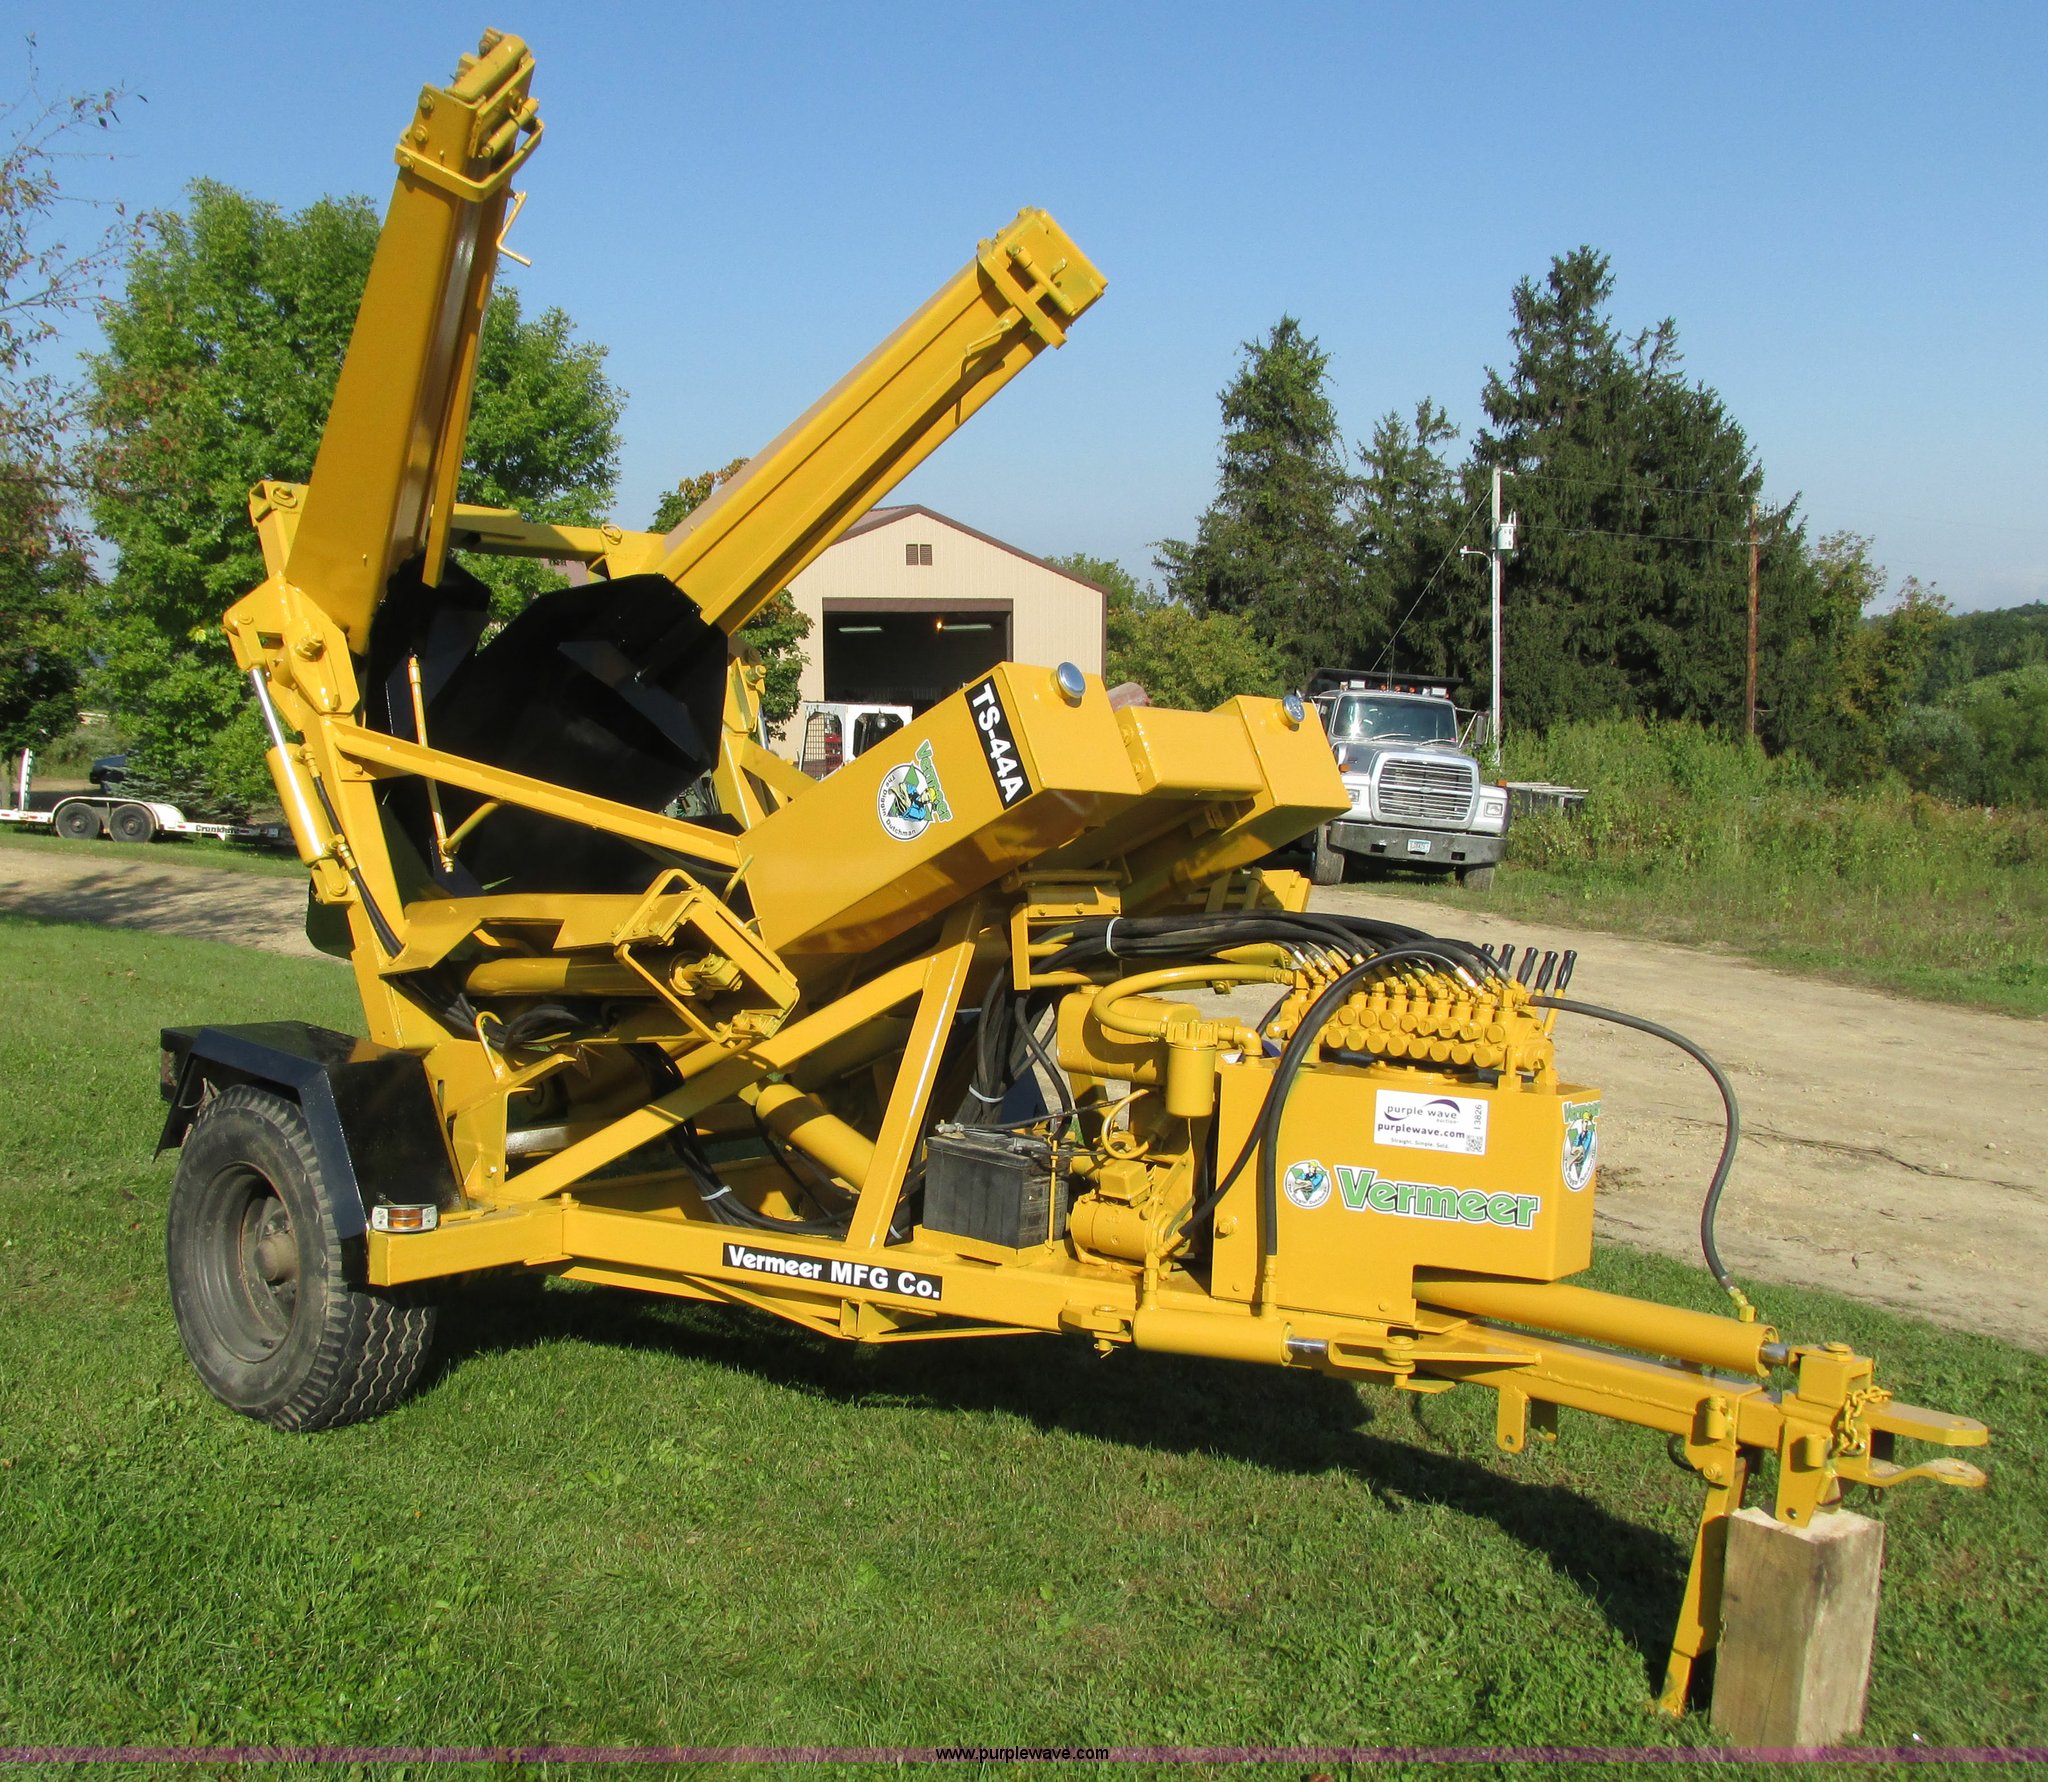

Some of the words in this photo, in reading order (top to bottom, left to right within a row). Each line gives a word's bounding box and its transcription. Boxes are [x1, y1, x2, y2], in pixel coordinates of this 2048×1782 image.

[972, 682, 1024, 803] TS-44A
[916, 740, 952, 820] Vermeer
[886, 819, 916, 836] Dutchman
[1378, 1123, 1465, 1139] purplewave.com
[1387, 1105, 1423, 1115] purple
[1427, 1110, 1457, 1119] wave
[1474, 1104, 1482, 1130] 13826
[1336, 1167, 1538, 1227] Vermeer
[728, 1245, 823, 1279] Vermeer
[830, 1260, 889, 1290] MFG
[897, 1272, 940, 1299] Co.
